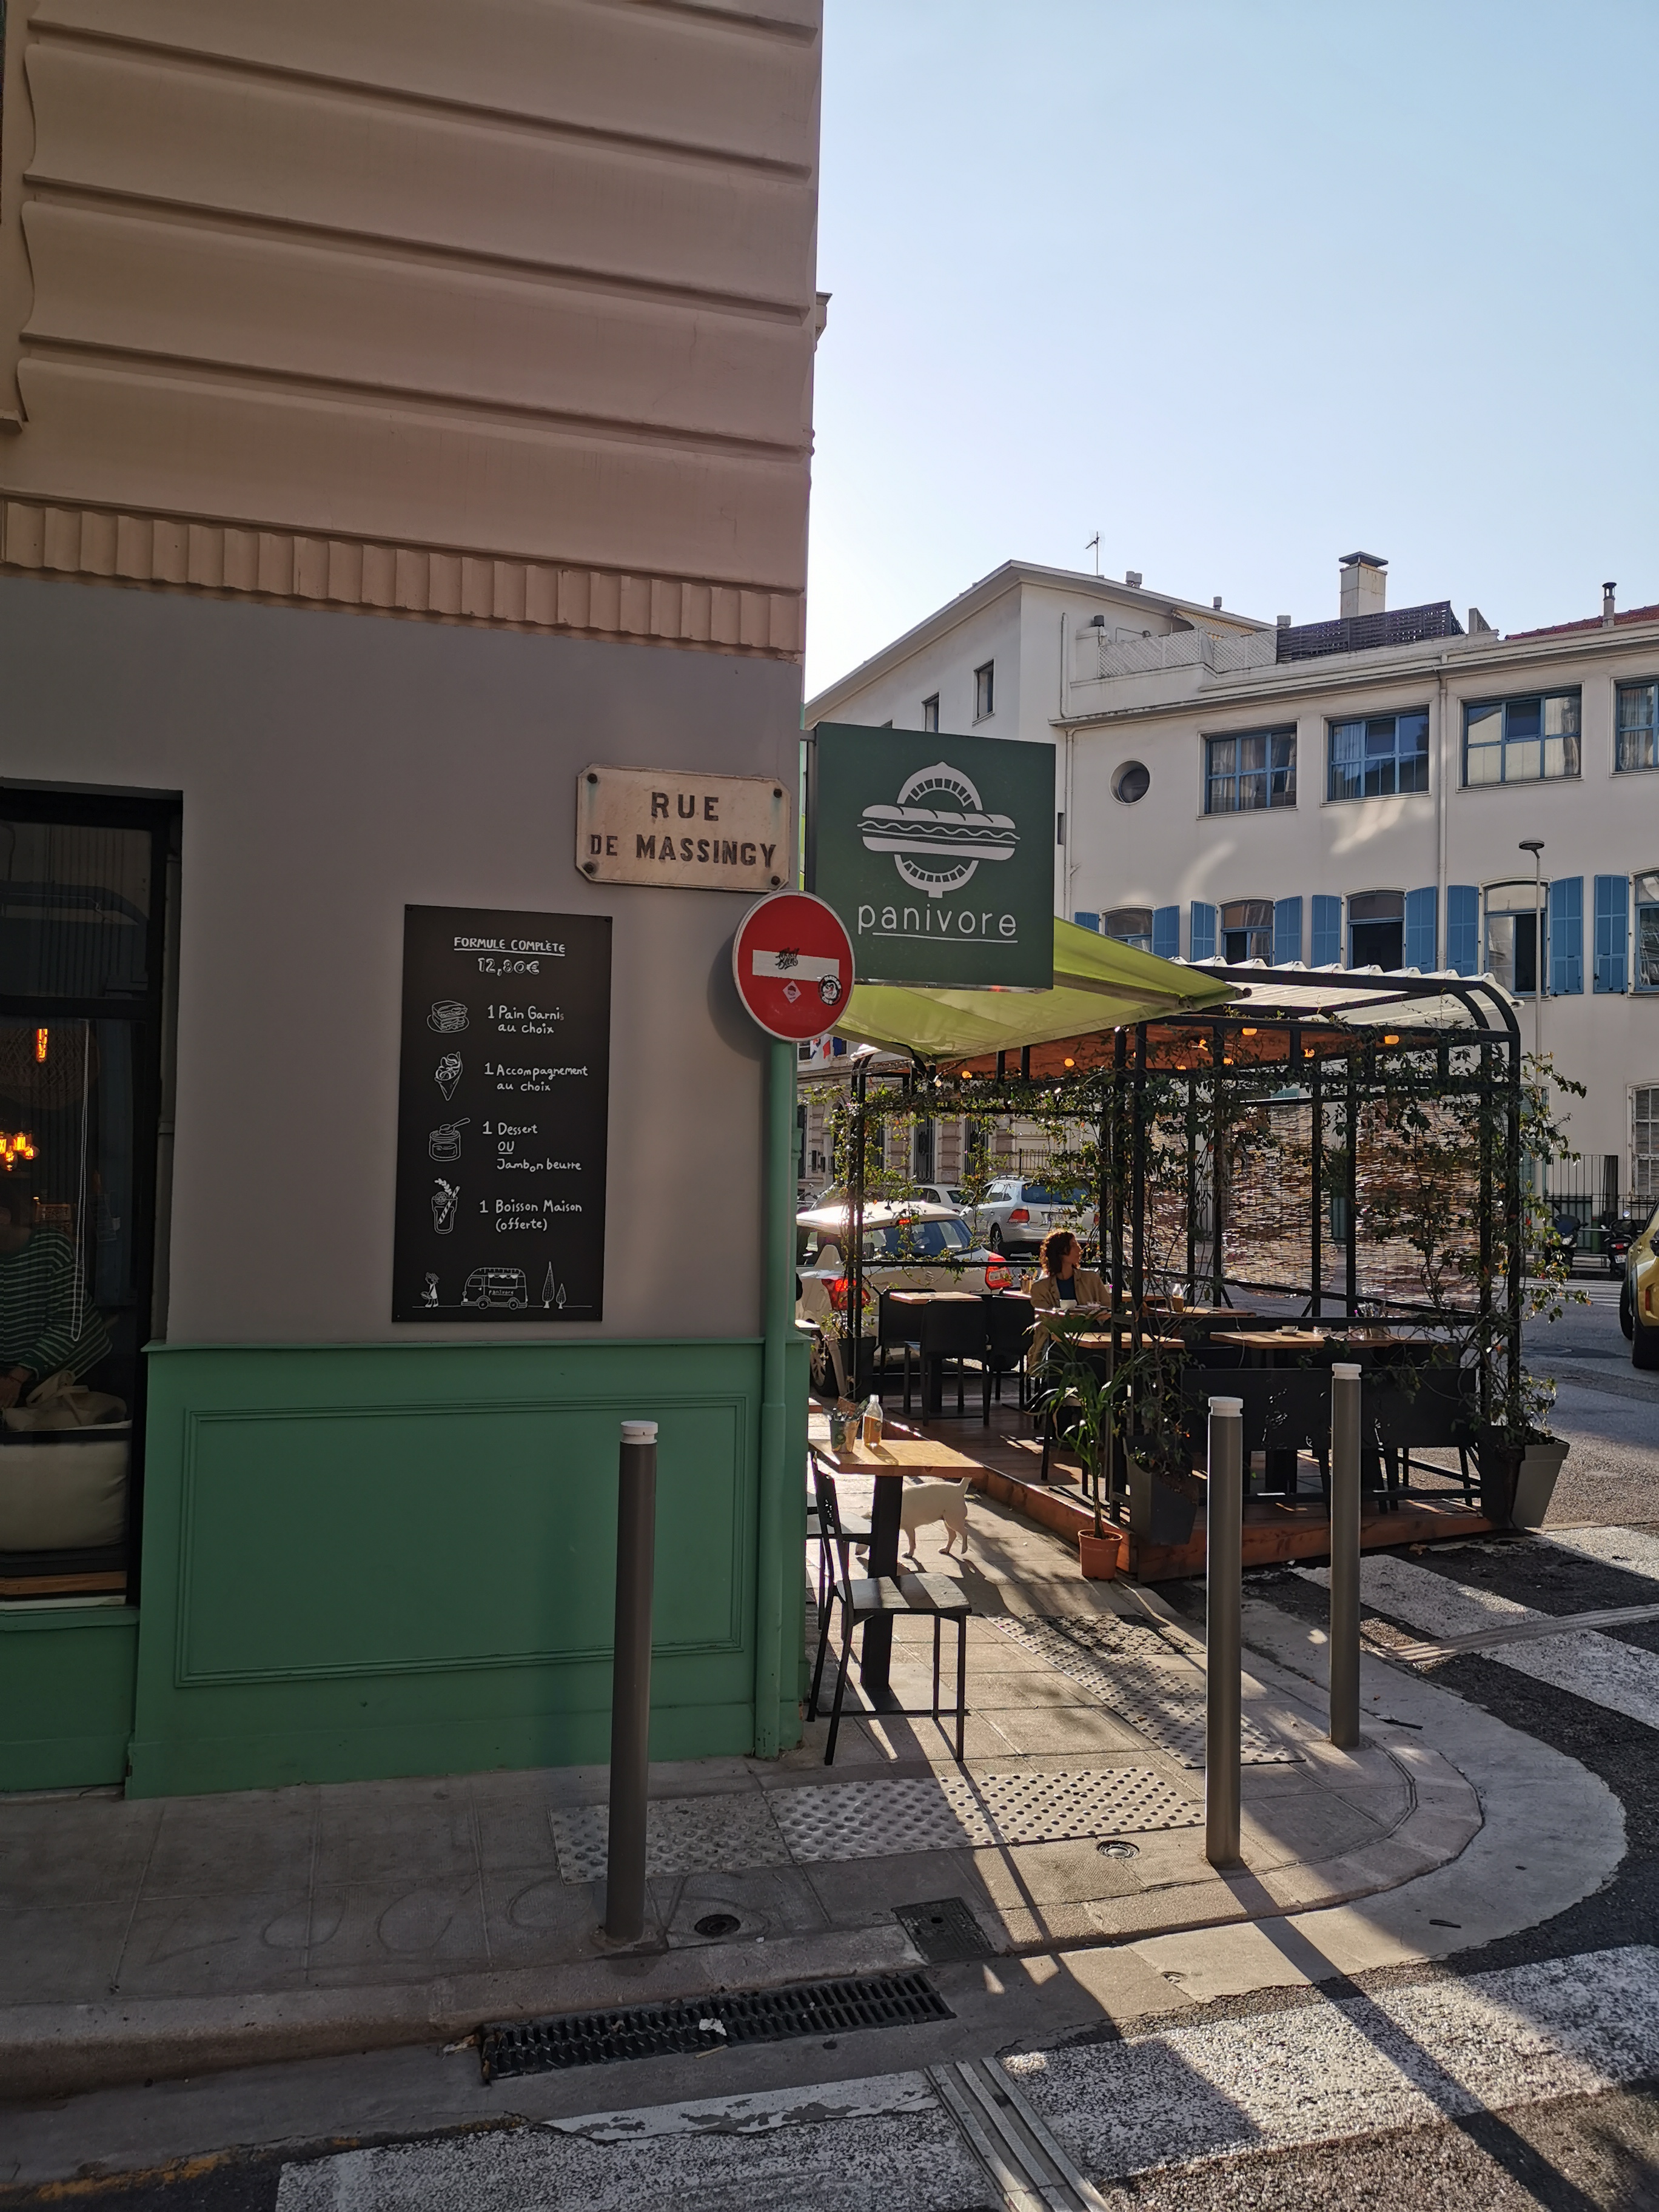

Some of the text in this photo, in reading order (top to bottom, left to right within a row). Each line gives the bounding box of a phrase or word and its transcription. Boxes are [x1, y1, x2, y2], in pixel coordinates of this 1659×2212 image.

[651, 791, 720, 821] RUE
[590, 834, 776, 868] DE MASSINGY
[858, 903, 1017, 936] panivore
[454, 936, 566, 953] FORMULE COMPLÈTE
[477, 957, 540, 976] 12,80€
[487, 1004, 565, 1021] 1 Pain Garnis
[497, 1022, 554, 1034] au choix
[484, 1062, 589, 1081] 1 Accompagnement
[497, 1081, 551, 1091] au choix
[482, 1121, 538, 1136] 1 Dessert
[497, 1141, 515, 1152] OU
[496, 1157, 582, 1172] Jambon beurre
[479, 1199, 583, 1214] 1 Boisson Maison
[495, 1218, 548, 1233] (offerte)
